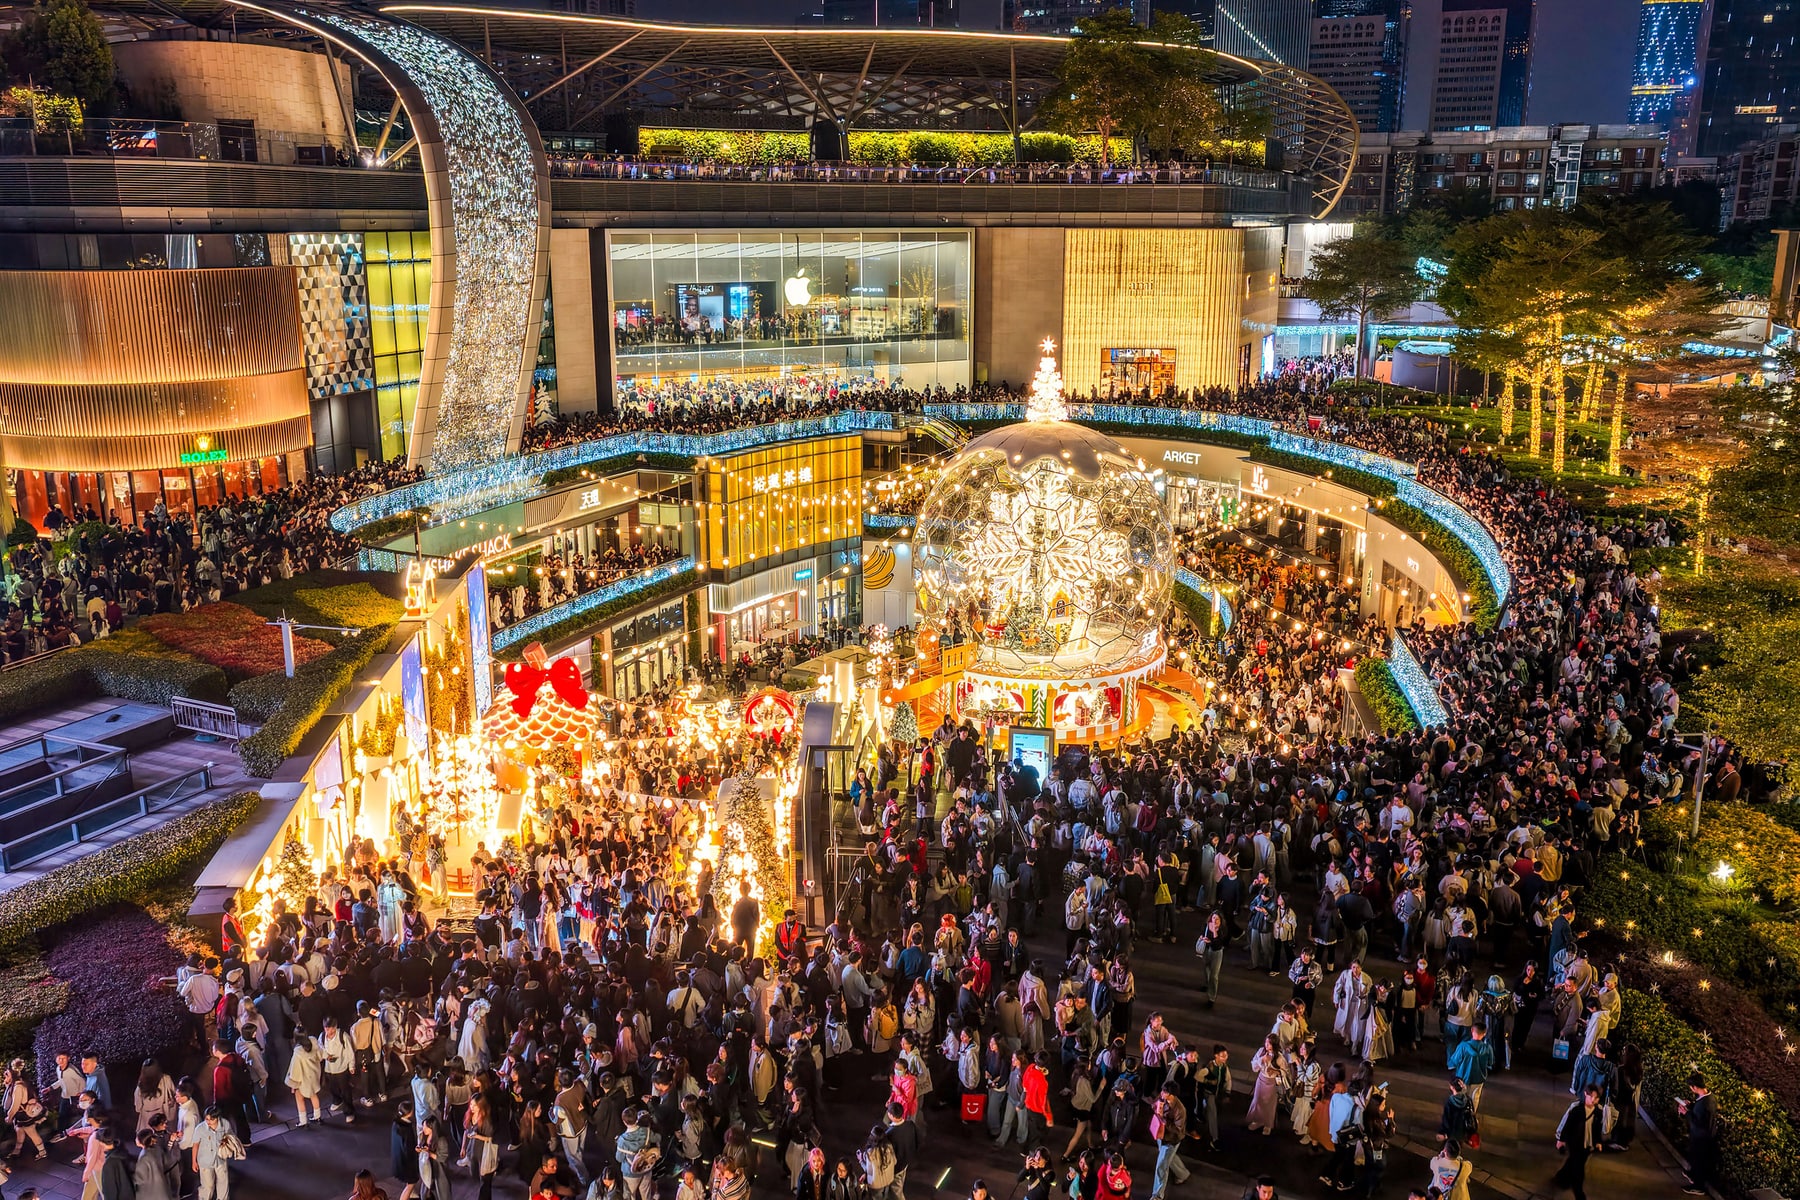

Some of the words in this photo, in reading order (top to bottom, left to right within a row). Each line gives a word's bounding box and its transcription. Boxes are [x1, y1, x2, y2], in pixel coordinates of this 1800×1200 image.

[1129, 280, 1153, 290] ami
[181, 450, 227, 464] ROLEX
[1163, 450, 1201, 465] ARKET
